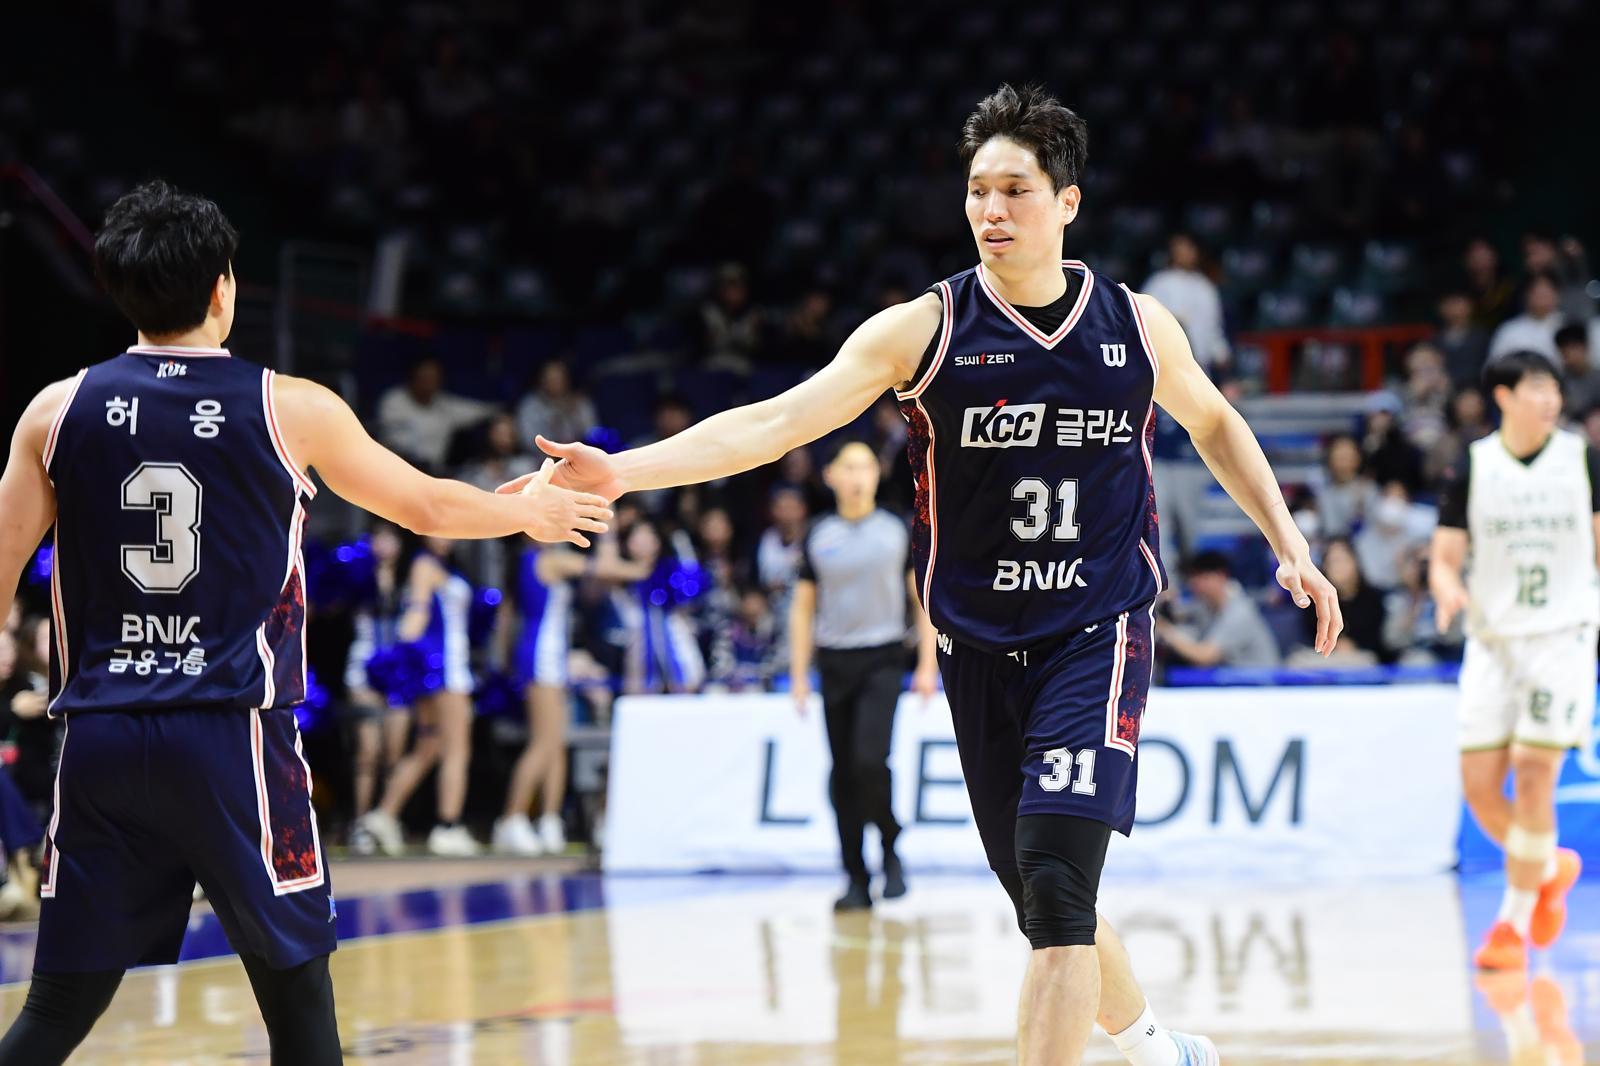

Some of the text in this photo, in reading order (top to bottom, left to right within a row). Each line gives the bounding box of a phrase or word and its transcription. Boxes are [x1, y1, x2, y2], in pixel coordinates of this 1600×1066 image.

[105, 396, 226, 439] 허 웅
[967, 399, 1133, 447] KCC 글라스
[120, 461, 203, 594] 3
[1009, 477, 1081, 542] 31
[992, 557, 1088, 592] BNK
[1515, 564, 1548, 607] 12
[121, 614, 201, 645] BNK
[108, 647, 207, 676] 금융그룹
[1038, 747, 1097, 796] 31
